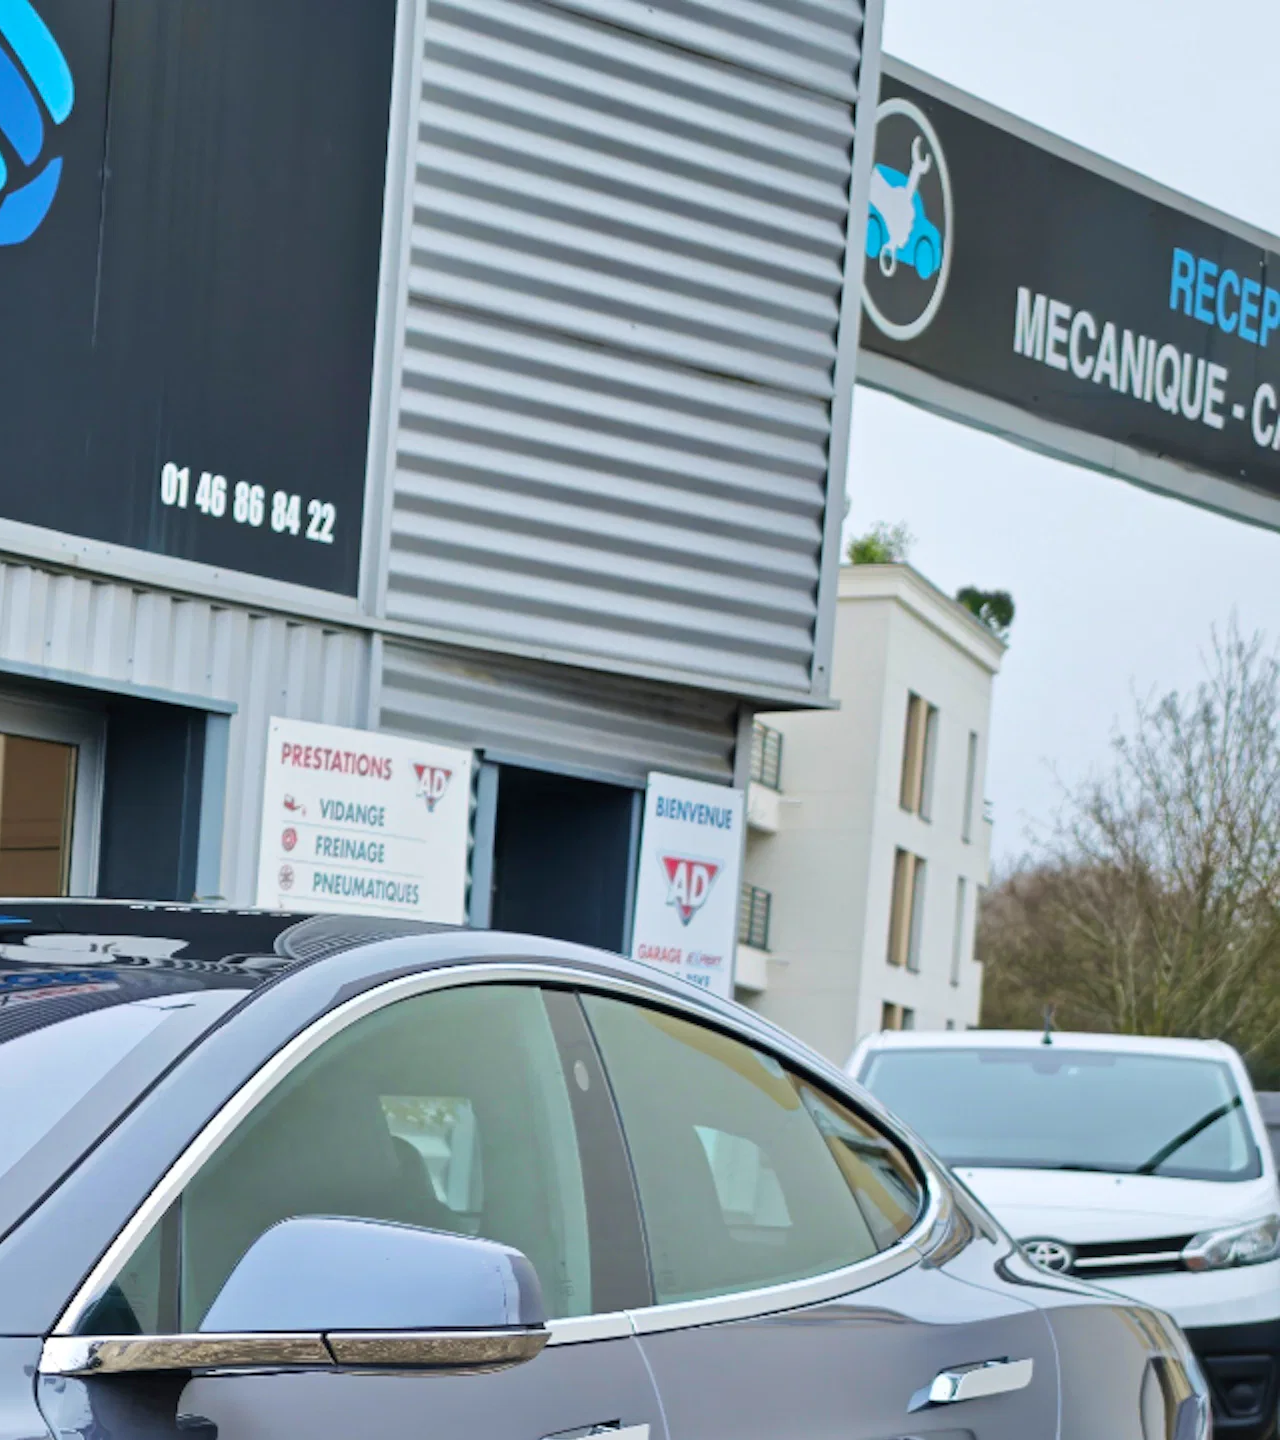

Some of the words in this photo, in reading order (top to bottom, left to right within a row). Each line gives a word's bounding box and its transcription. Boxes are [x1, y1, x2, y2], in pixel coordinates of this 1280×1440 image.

[1013, 286, 1228, 431] MECANIQUE
[161, 462, 190, 509] 01
[195, 471, 228, 518] 46
[233, 481, 266, 527] 86
[271, 490, 302, 536] 84
[305, 498, 337, 545] 22
[280, 741, 393, 781] PRESTATIONS
[416, 768, 448, 800] AD
[319, 798, 386, 828] VIDANGE
[655, 796, 734, 830] BIENVENUE
[314, 834, 386, 864] FREINAGE
[311, 871, 420, 905] PNEUMATIQUES
[664, 860, 710, 908] AD
[638, 943, 682, 965] GARAGE
